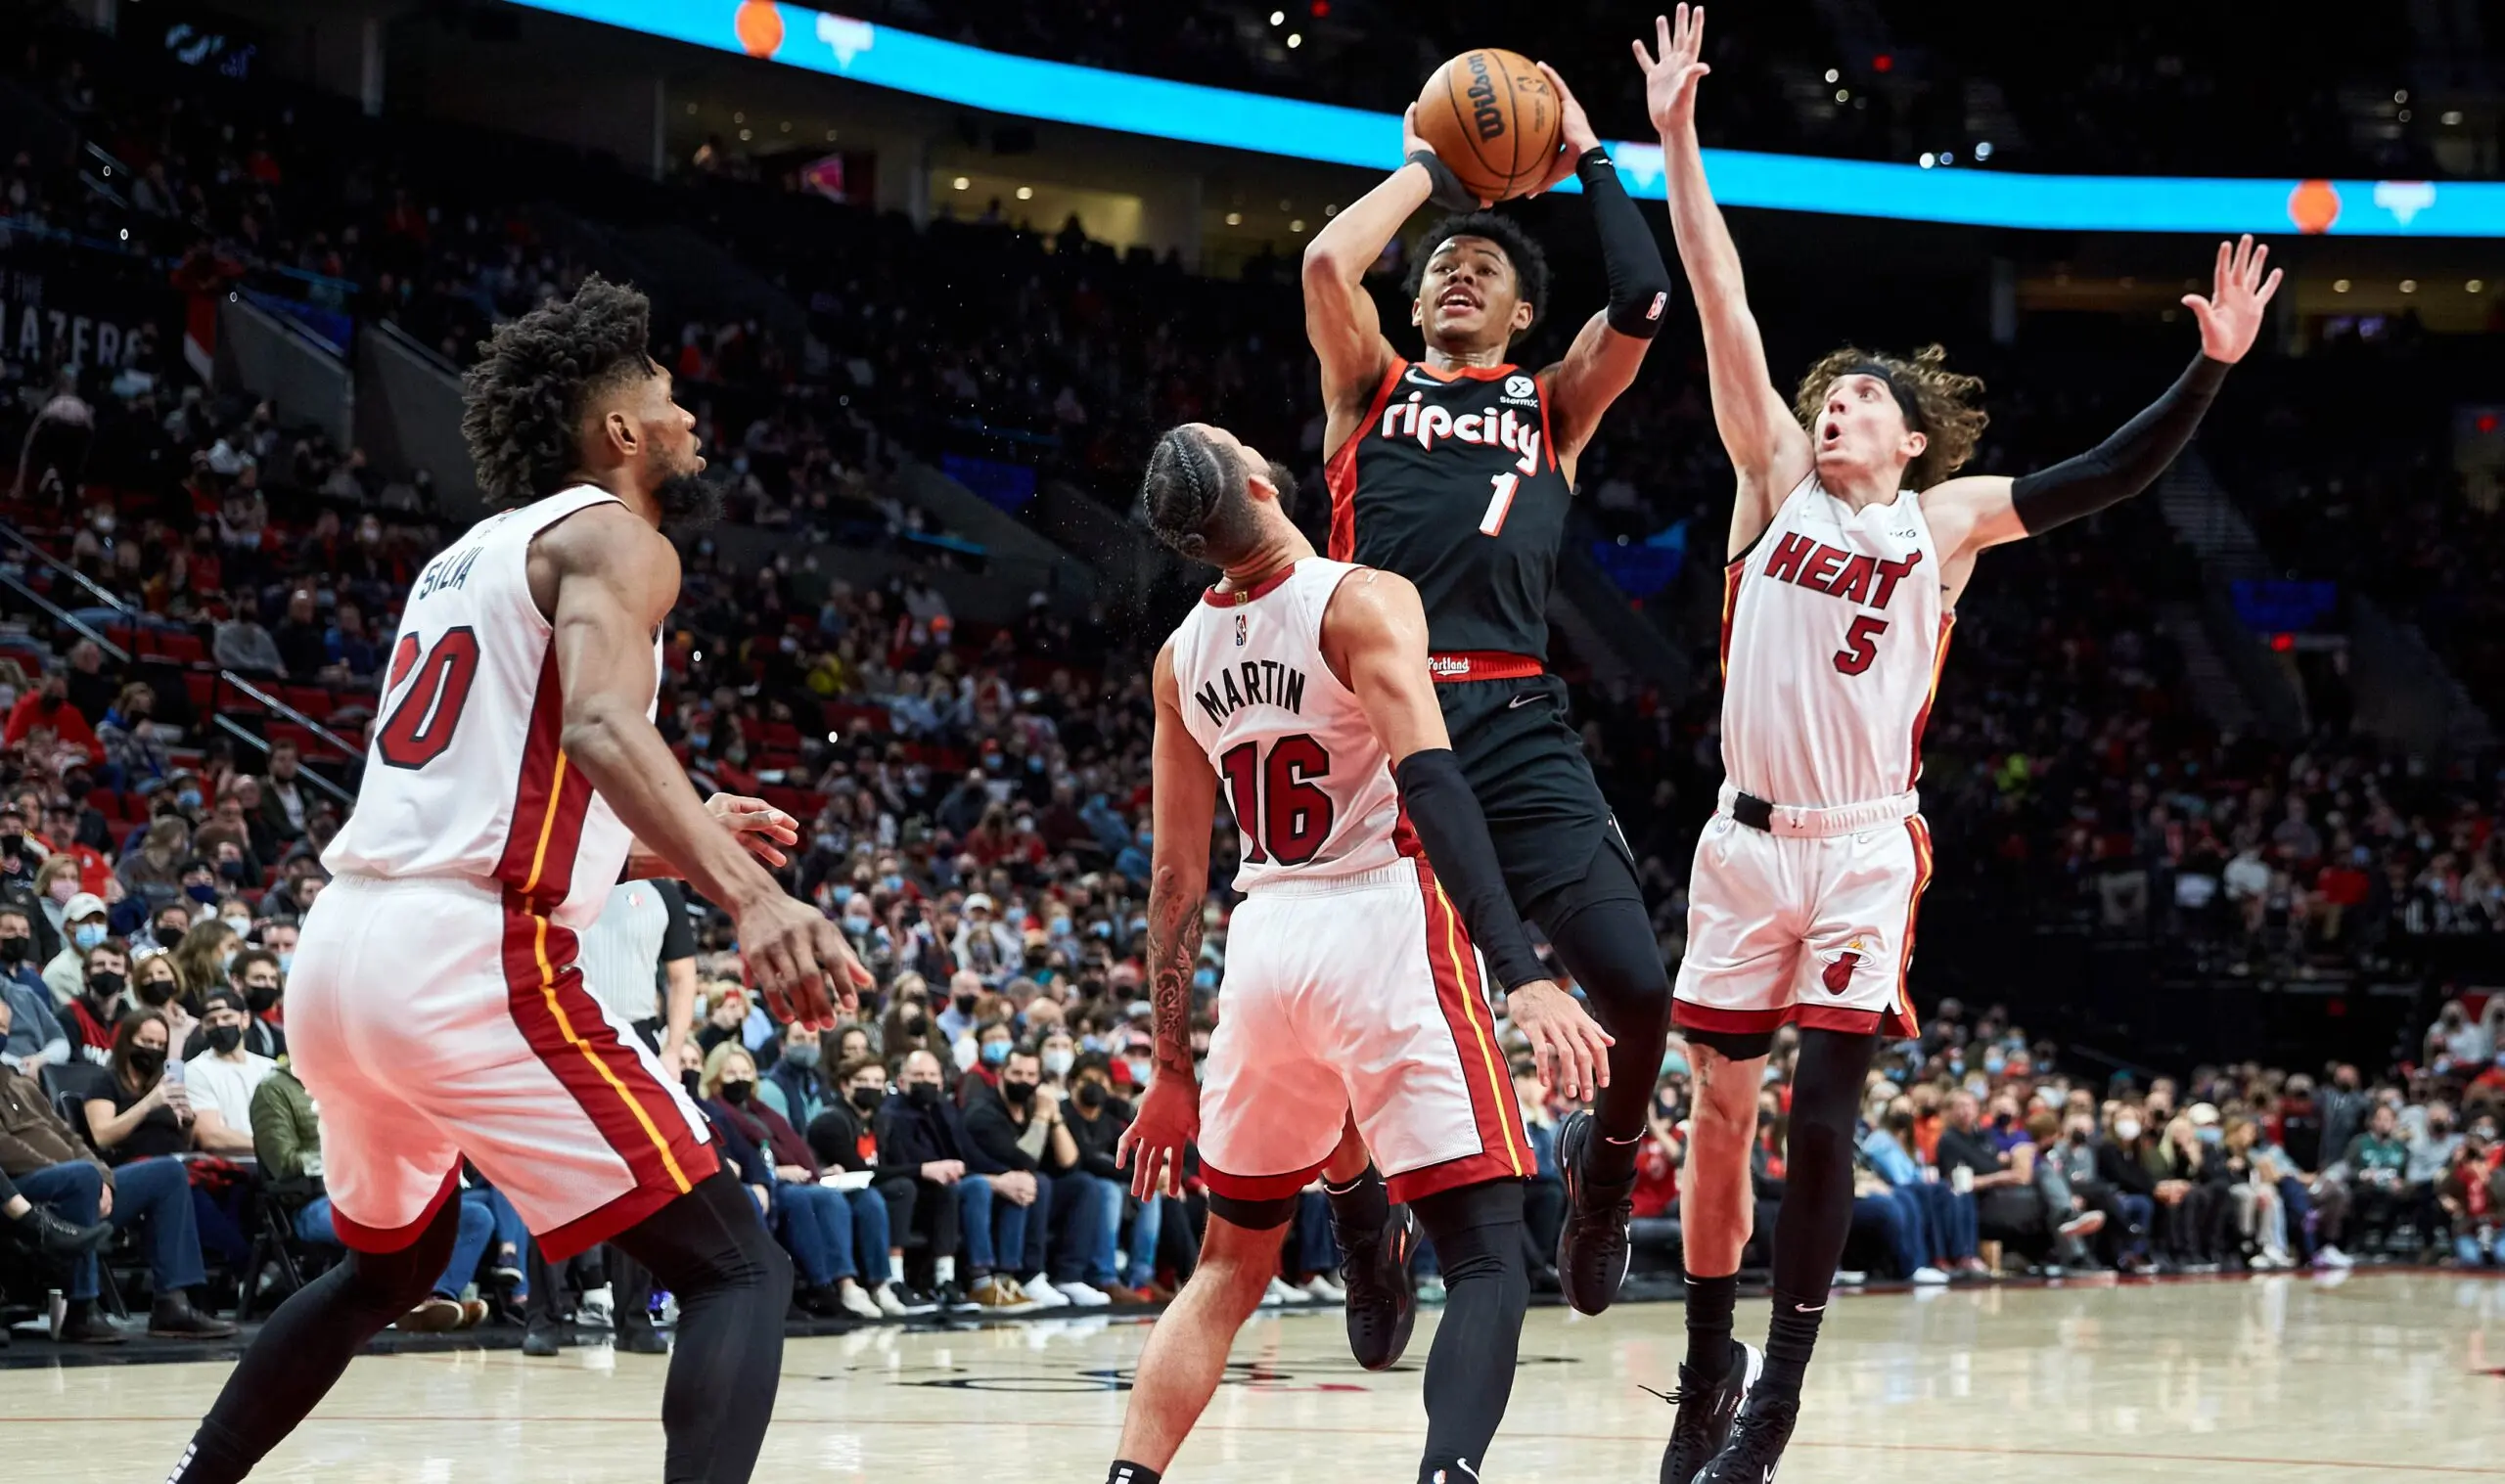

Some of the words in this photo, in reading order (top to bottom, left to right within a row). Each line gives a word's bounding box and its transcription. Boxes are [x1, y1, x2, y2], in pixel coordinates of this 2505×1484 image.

[1468, 53, 1505, 144] Wilson
[0, 296, 144, 368] AZER
[1382, 391, 1540, 476] ripcity
[1479, 472, 1520, 537] 1
[418, 547, 484, 601] SILVA
[1764, 531, 1922, 610] HEAT
[1428, 656, 1470, 676] Portland
[1833, 614, 1890, 677] 5
[1195, 659, 1306, 728] MARTIN
[1220, 733, 1335, 867] 16
